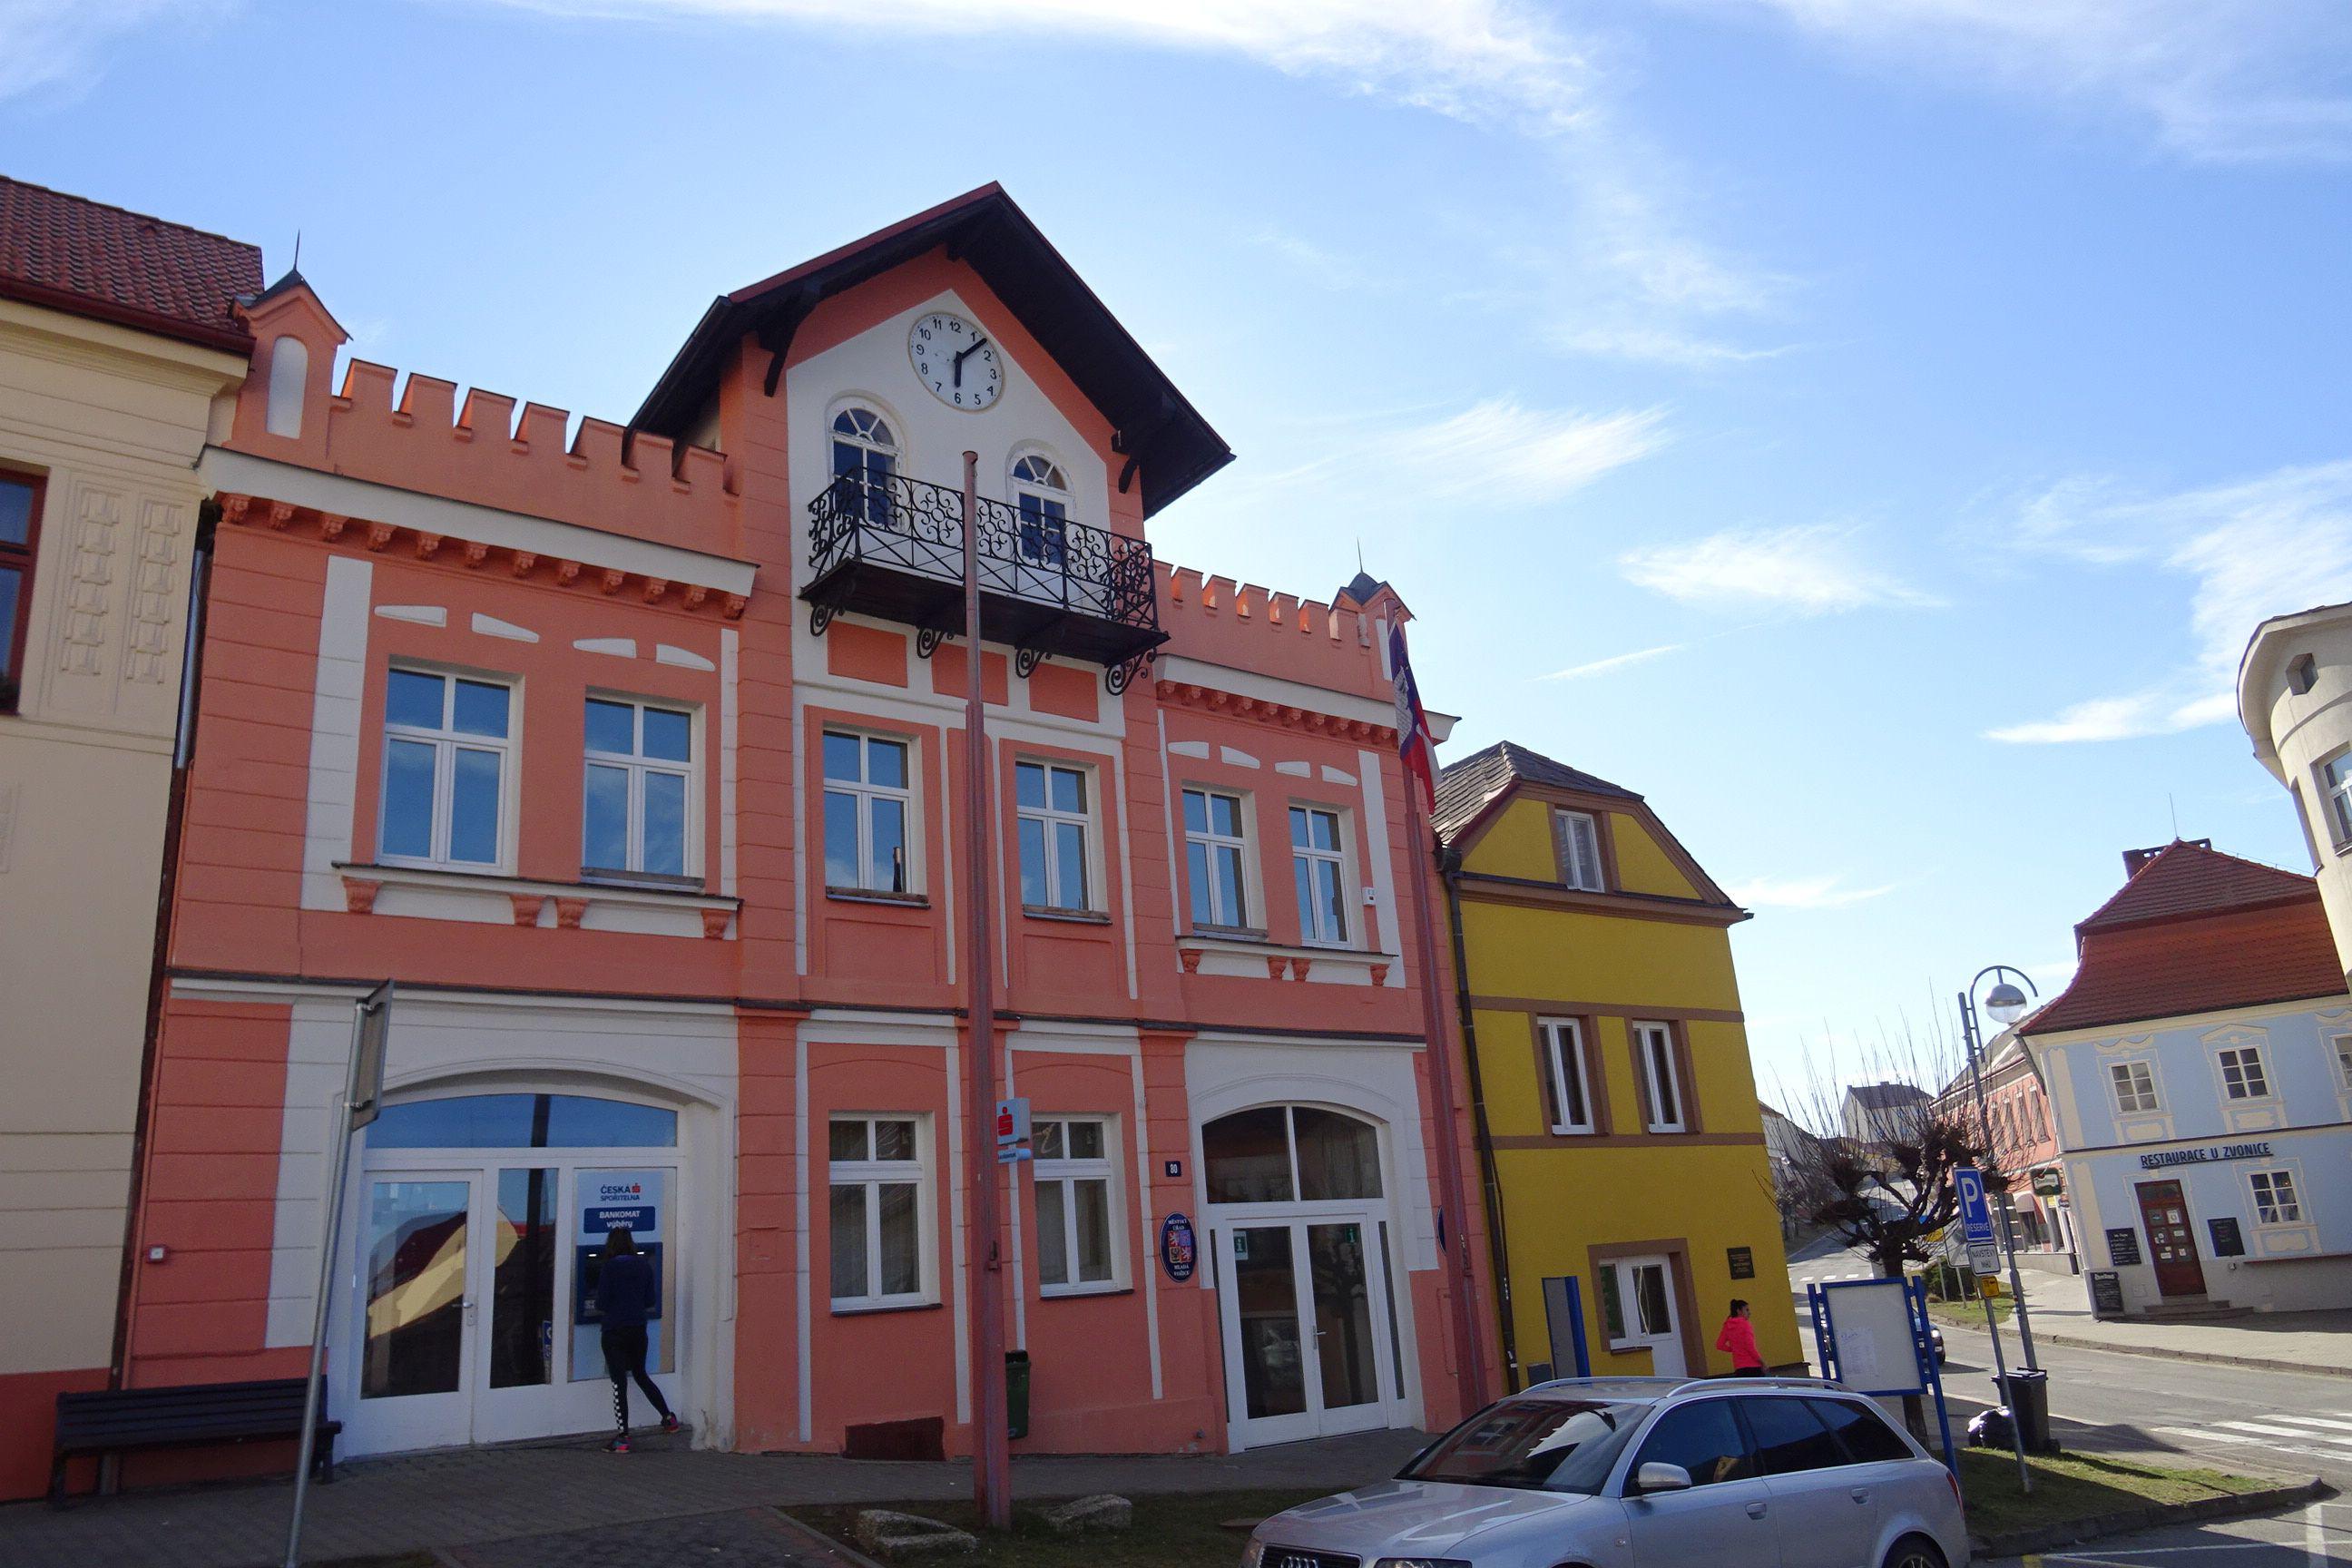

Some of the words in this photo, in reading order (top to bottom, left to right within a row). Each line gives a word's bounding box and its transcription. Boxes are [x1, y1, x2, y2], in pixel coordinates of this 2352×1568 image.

[933, 318, 942, 330] 11
[949, 320, 961, 333] 12
[919, 328, 931, 340] 10
[970, 332, 975, 341] 1
[916, 344, 925, 355] 9
[984, 350, 992, 362] 2
[921, 363, 928, 375] 8
[989, 368, 997, 379] 3
[935, 381, 942, 392] 7
[986, 386, 994, 396] 4
[954, 393, 961, 404] 6
[975, 394, 981, 405] 5
[2140, 1149, 2209, 1166] RESTAURACE
[2210, 1147, 2219, 1159] U
[2223, 1142, 2271, 1158] ZVONICE
[600, 1183, 631, 1194] ČESKÁ
[1961, 1177, 1978, 1218] P
